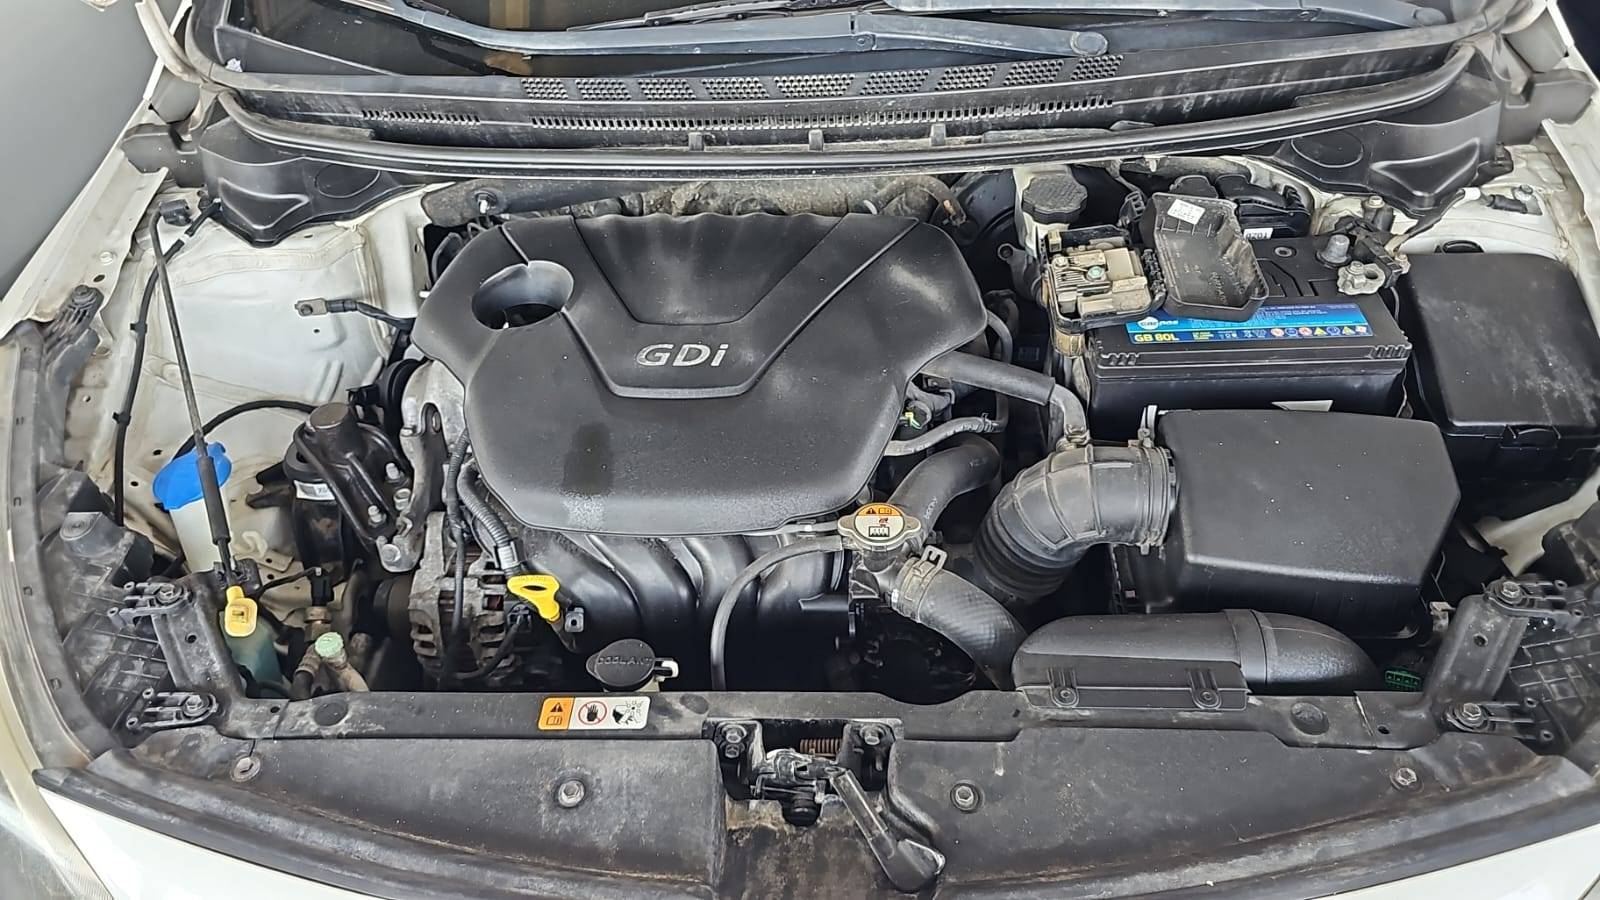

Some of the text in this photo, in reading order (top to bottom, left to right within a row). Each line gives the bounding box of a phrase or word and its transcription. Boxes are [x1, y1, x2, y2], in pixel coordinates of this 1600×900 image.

[1134, 333, 1180, 342] GB 80L
[636, 344, 729, 366] GDi
[598, 656, 654, 665] COOLANT
